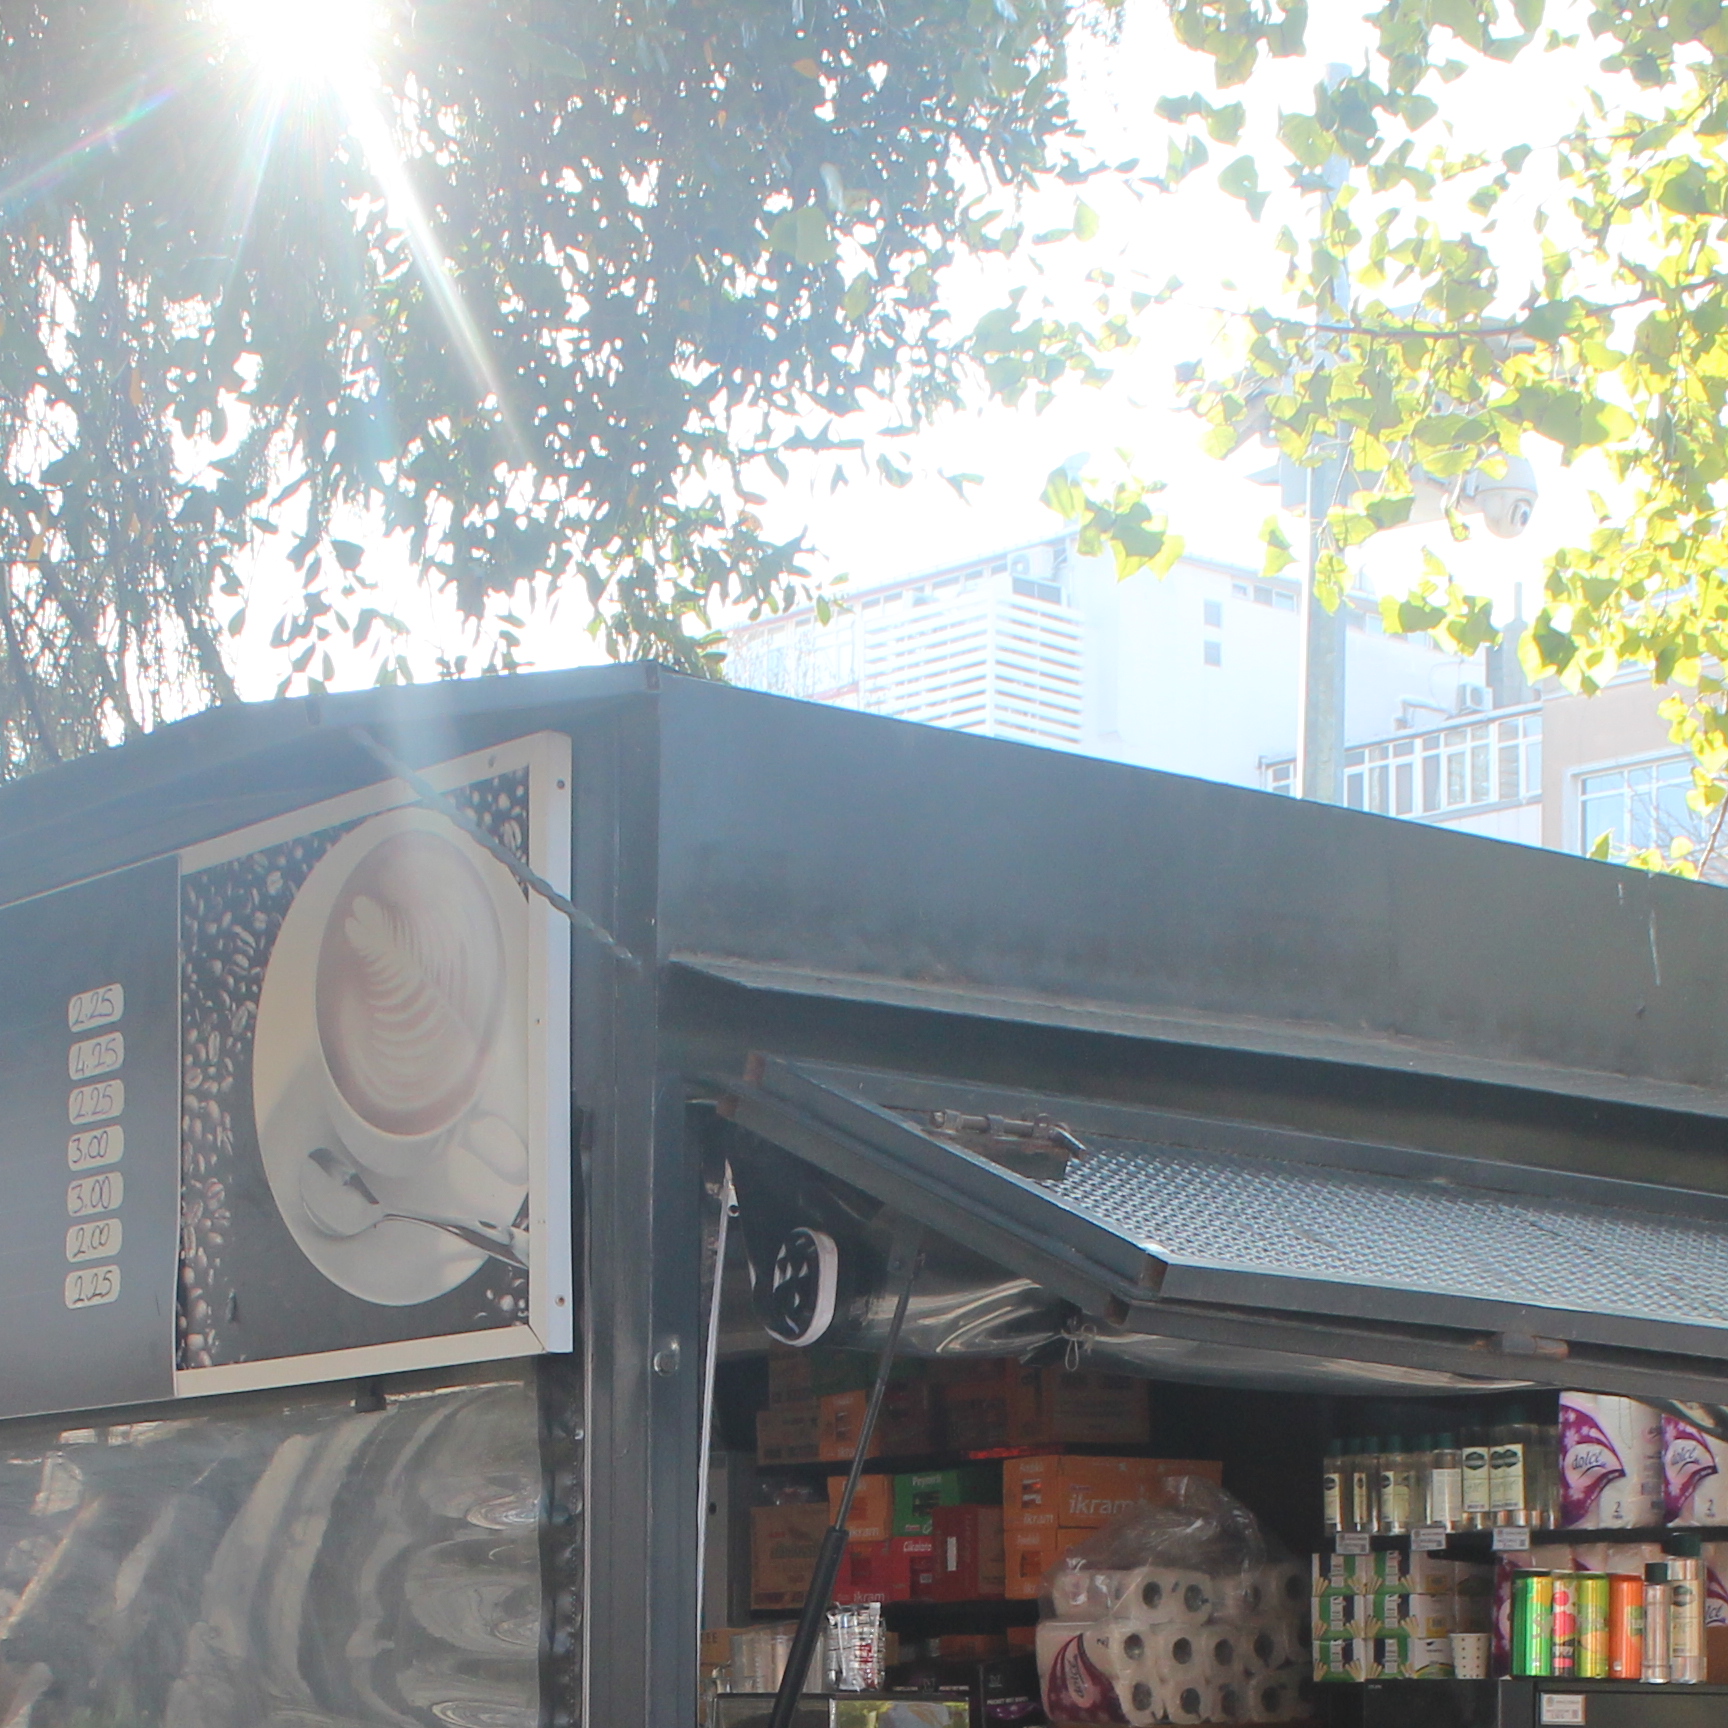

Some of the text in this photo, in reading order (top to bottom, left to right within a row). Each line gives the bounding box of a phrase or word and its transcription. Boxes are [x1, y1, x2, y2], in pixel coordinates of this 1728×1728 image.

[72, 1130, 108, 1165] 3.00
[71, 1175, 111, 1214] 3.00
[73, 1223, 110, 1257] 2.00
